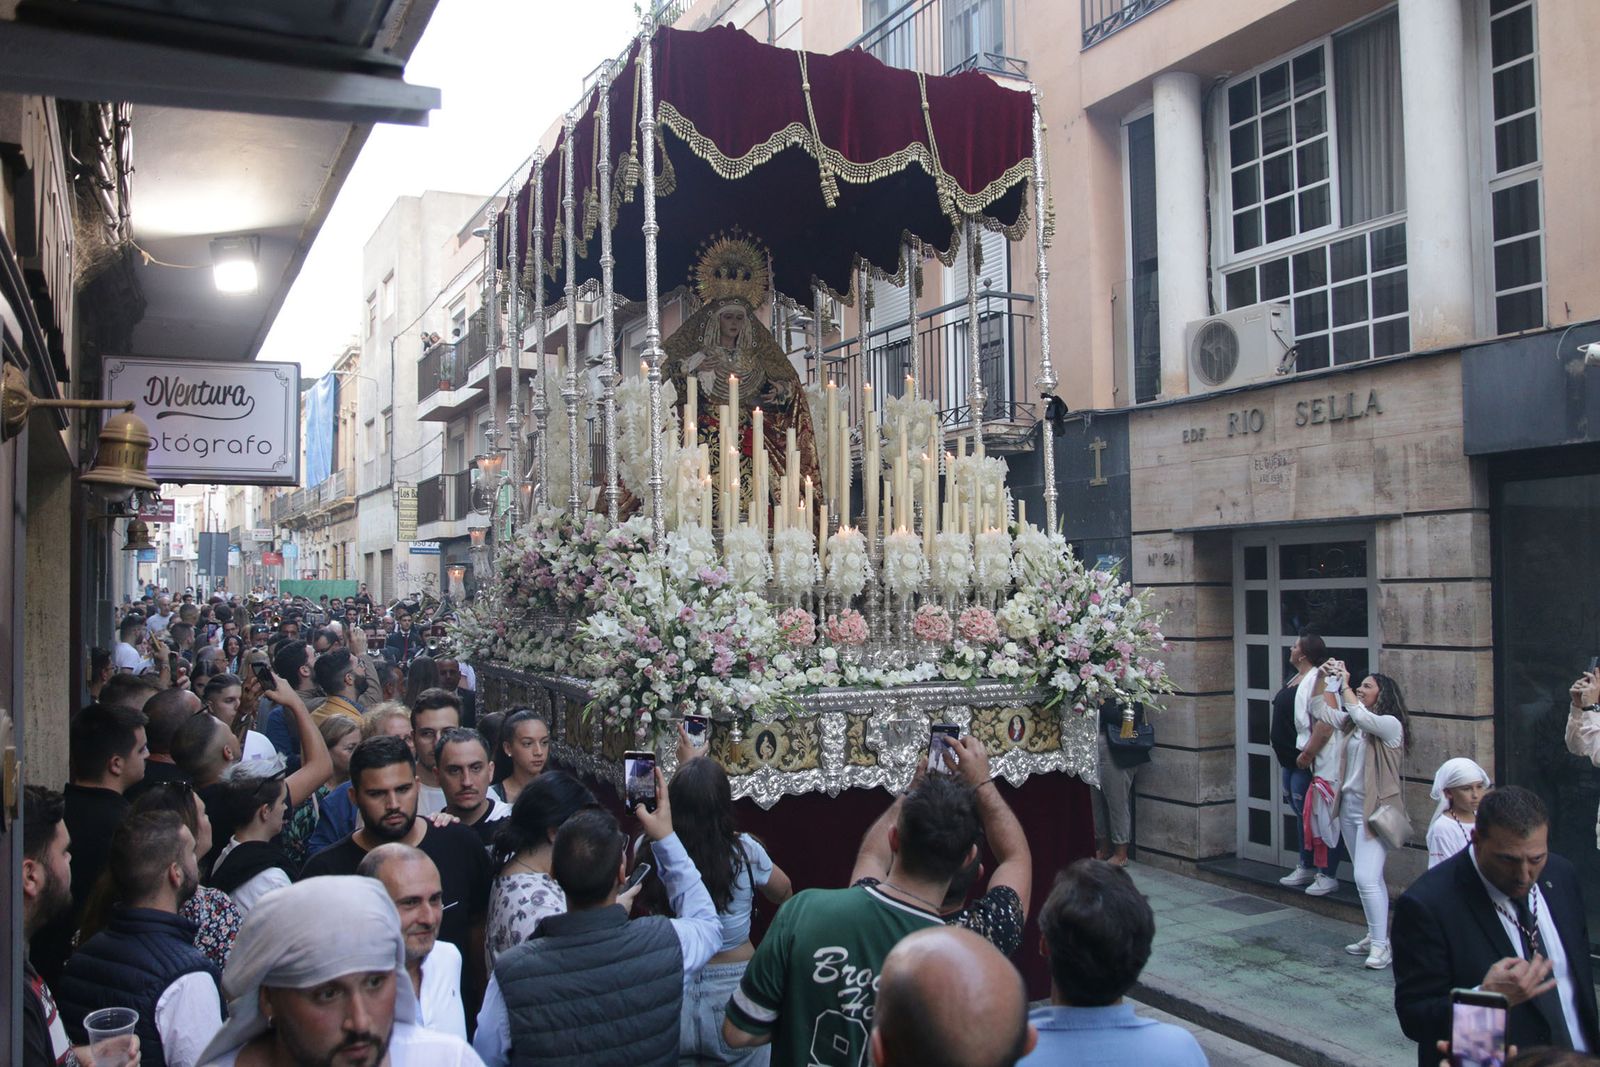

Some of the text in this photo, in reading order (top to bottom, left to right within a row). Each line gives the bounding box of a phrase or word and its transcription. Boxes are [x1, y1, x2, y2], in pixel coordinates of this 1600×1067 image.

[1182, 388, 1383, 444] EDF. RIO SELLA
[149, 432, 272, 458] otógrafo
